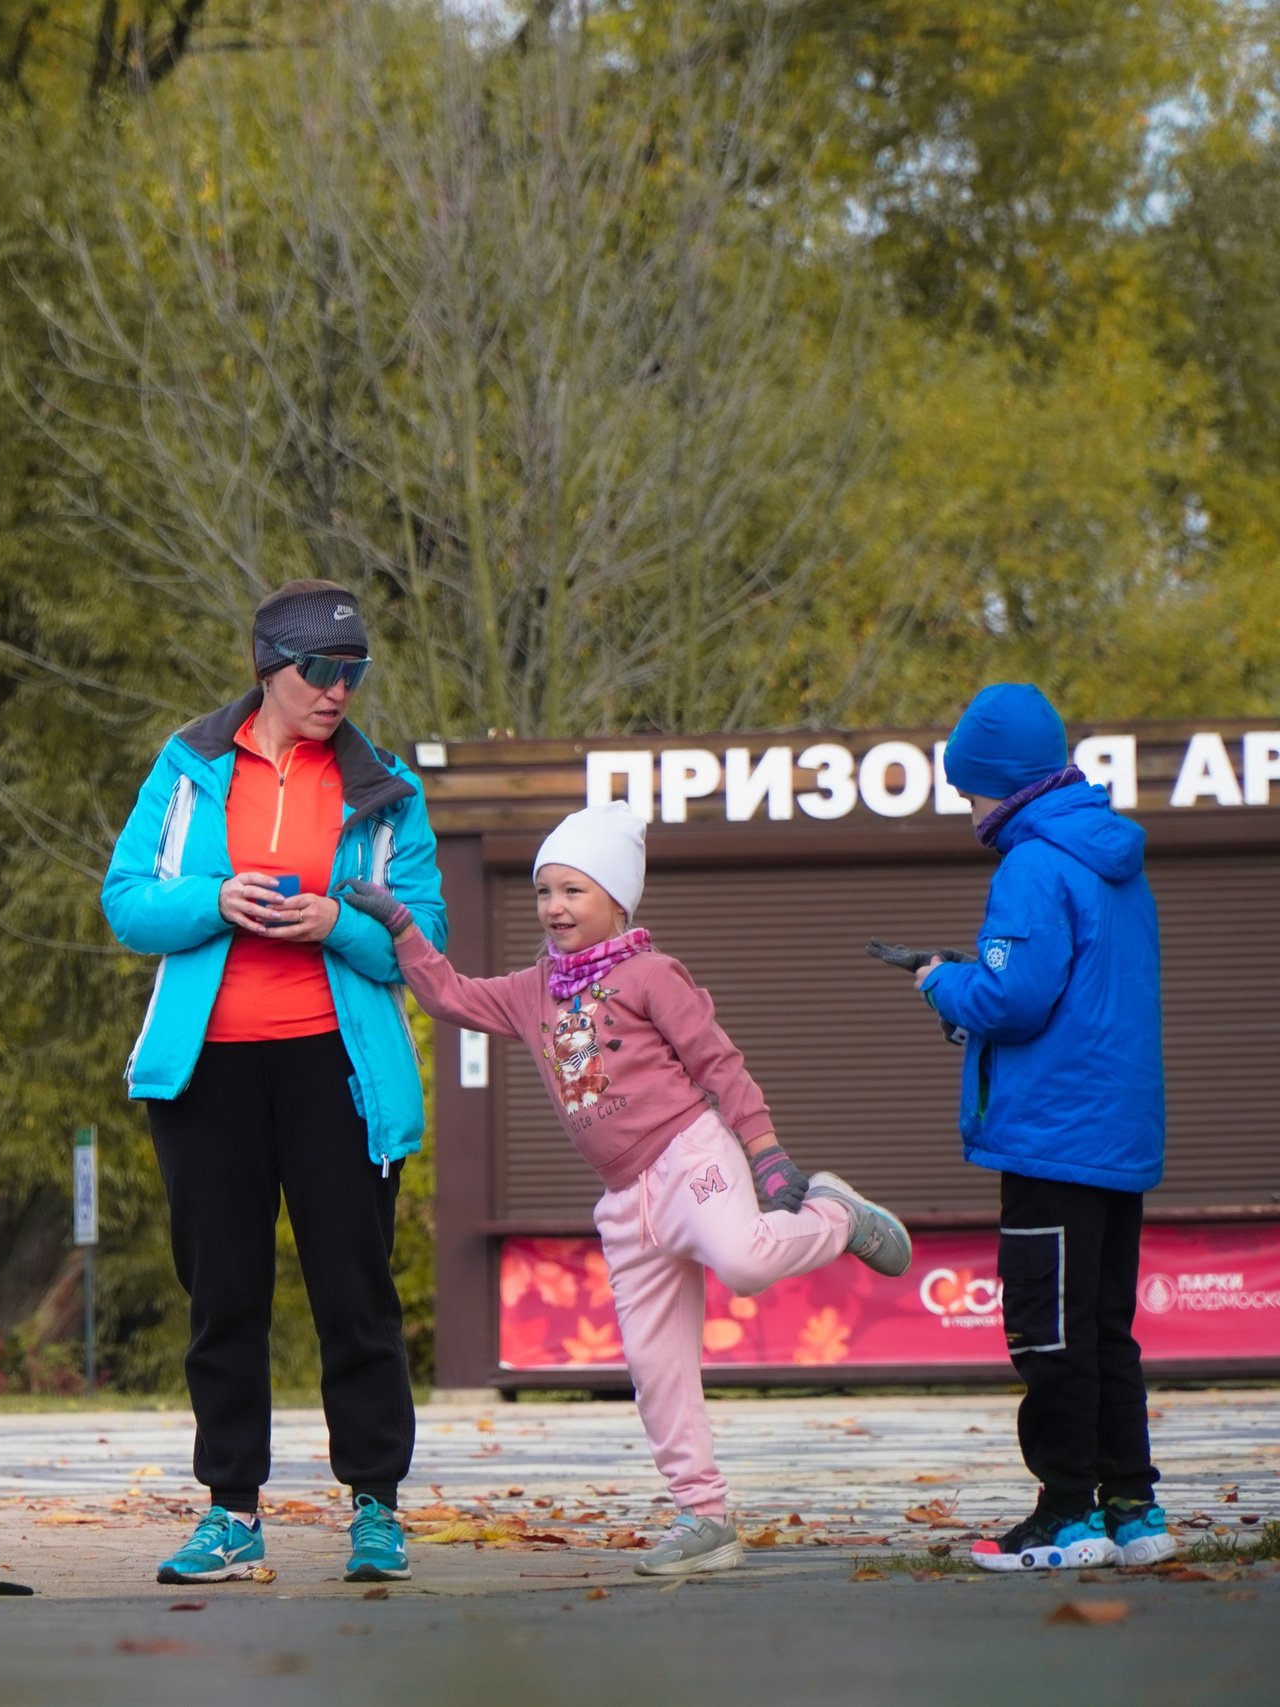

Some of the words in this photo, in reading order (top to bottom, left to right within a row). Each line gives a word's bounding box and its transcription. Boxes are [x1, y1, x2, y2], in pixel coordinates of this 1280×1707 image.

[587, 735, 1137, 824] ПРИЗОЯ
[597, 1096, 628, 1120] Cute
[689, 1164, 728, 1205] M
[1178, 1273, 1244, 1292] ПАРКИ
